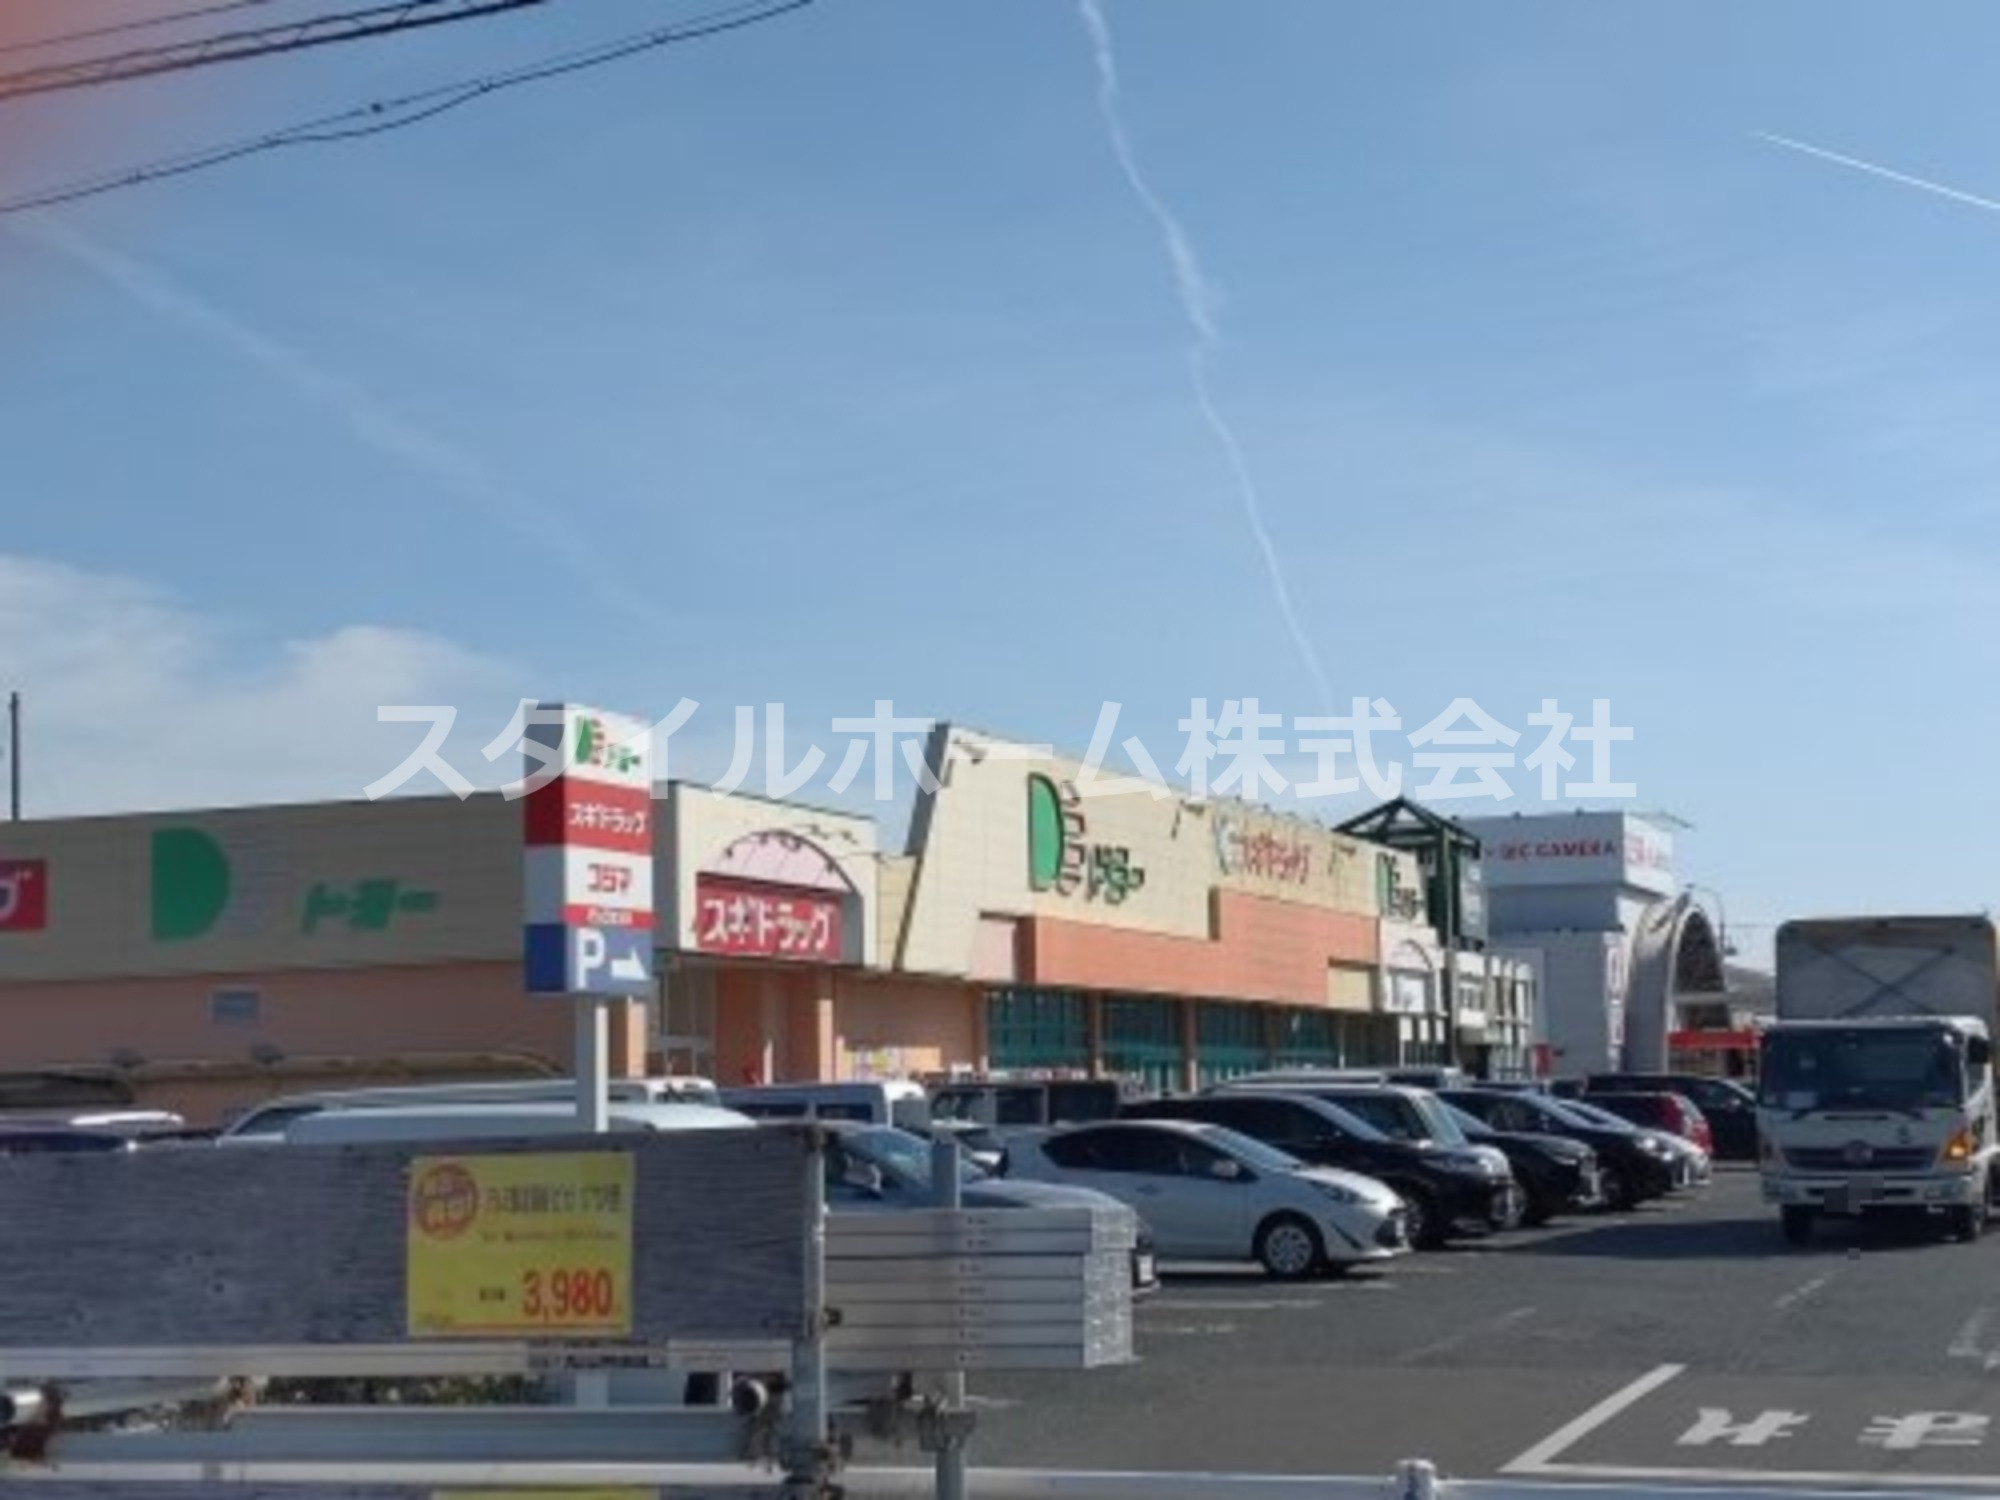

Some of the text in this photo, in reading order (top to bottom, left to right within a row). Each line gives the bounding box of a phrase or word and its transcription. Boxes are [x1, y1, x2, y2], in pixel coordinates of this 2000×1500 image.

[703, 897, 831, 951] スギドラッグ
[575, 929, 605, 988] P
[522, 1268, 613, 1321] 3,980
